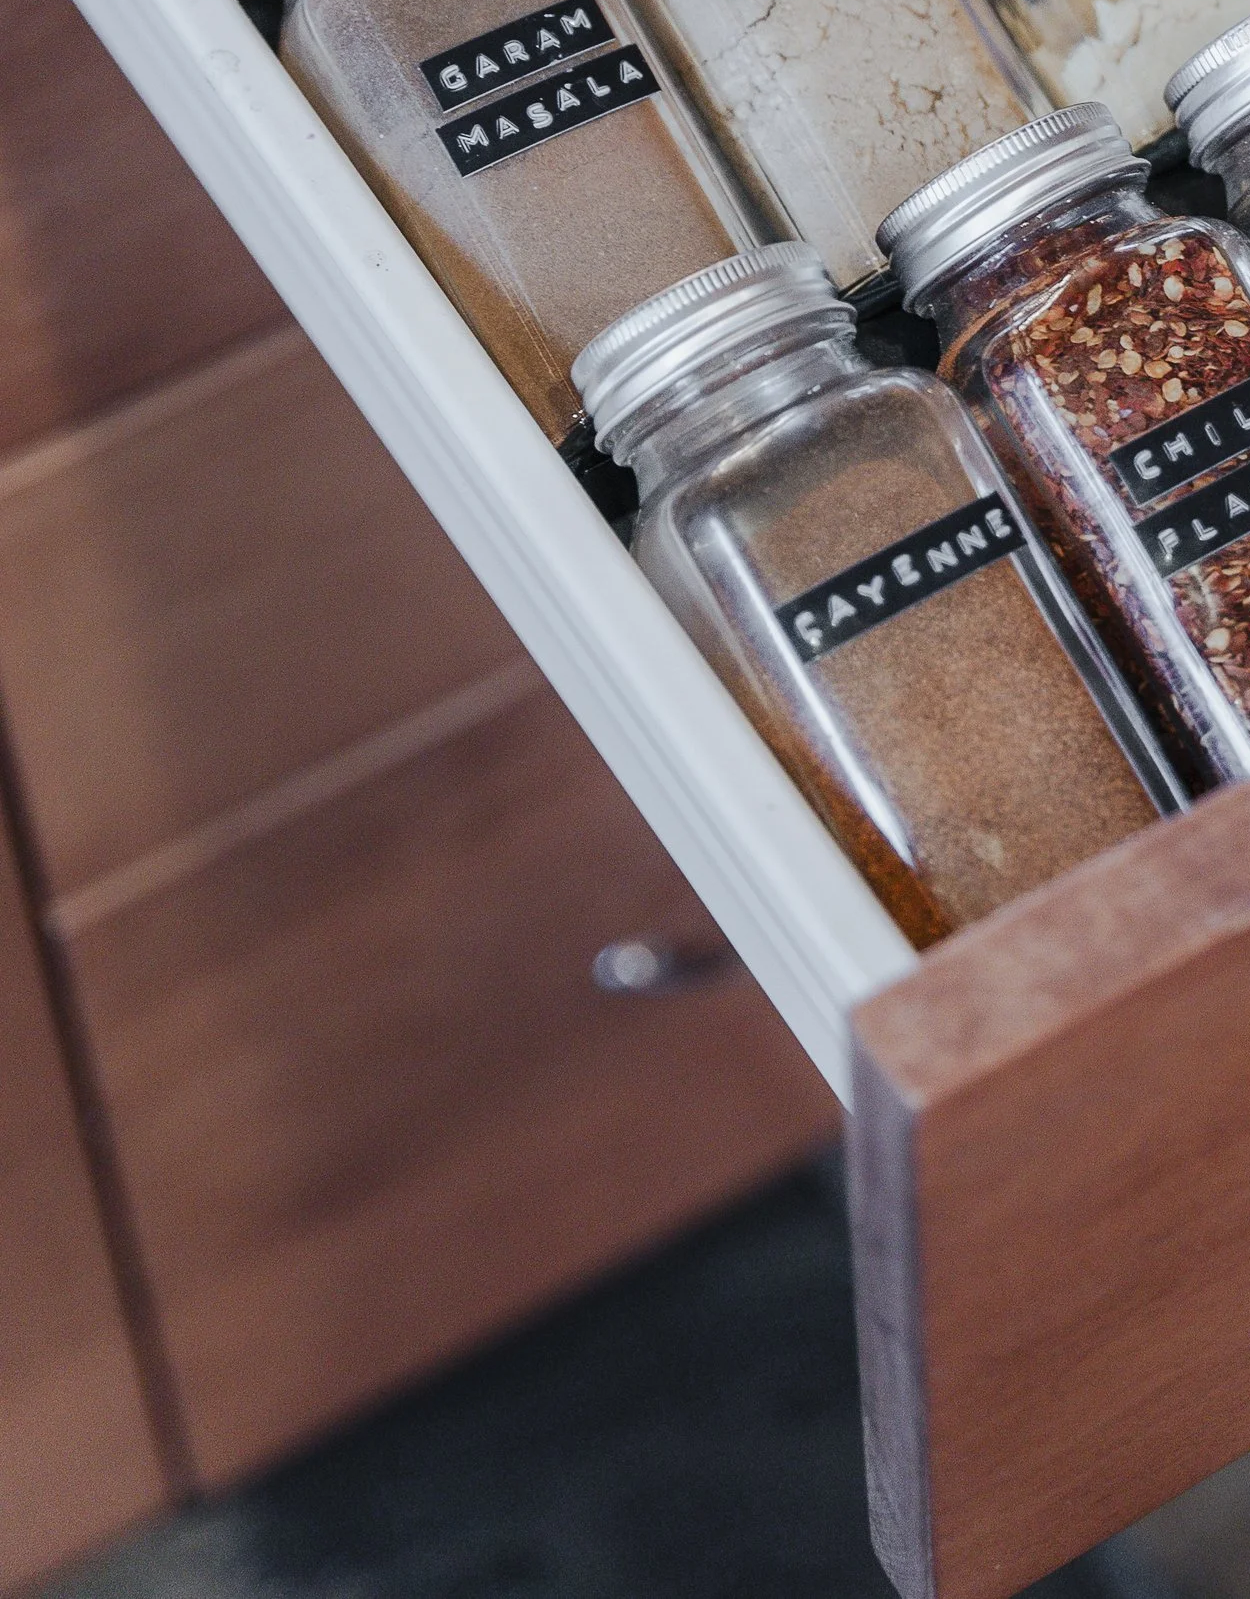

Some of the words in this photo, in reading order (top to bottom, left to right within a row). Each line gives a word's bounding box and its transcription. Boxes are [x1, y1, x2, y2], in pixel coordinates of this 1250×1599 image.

[439, 7, 593, 92] GARAM
[456, 59, 644, 154] MASALA
[794, 507, 1012, 648] CAYENNE
